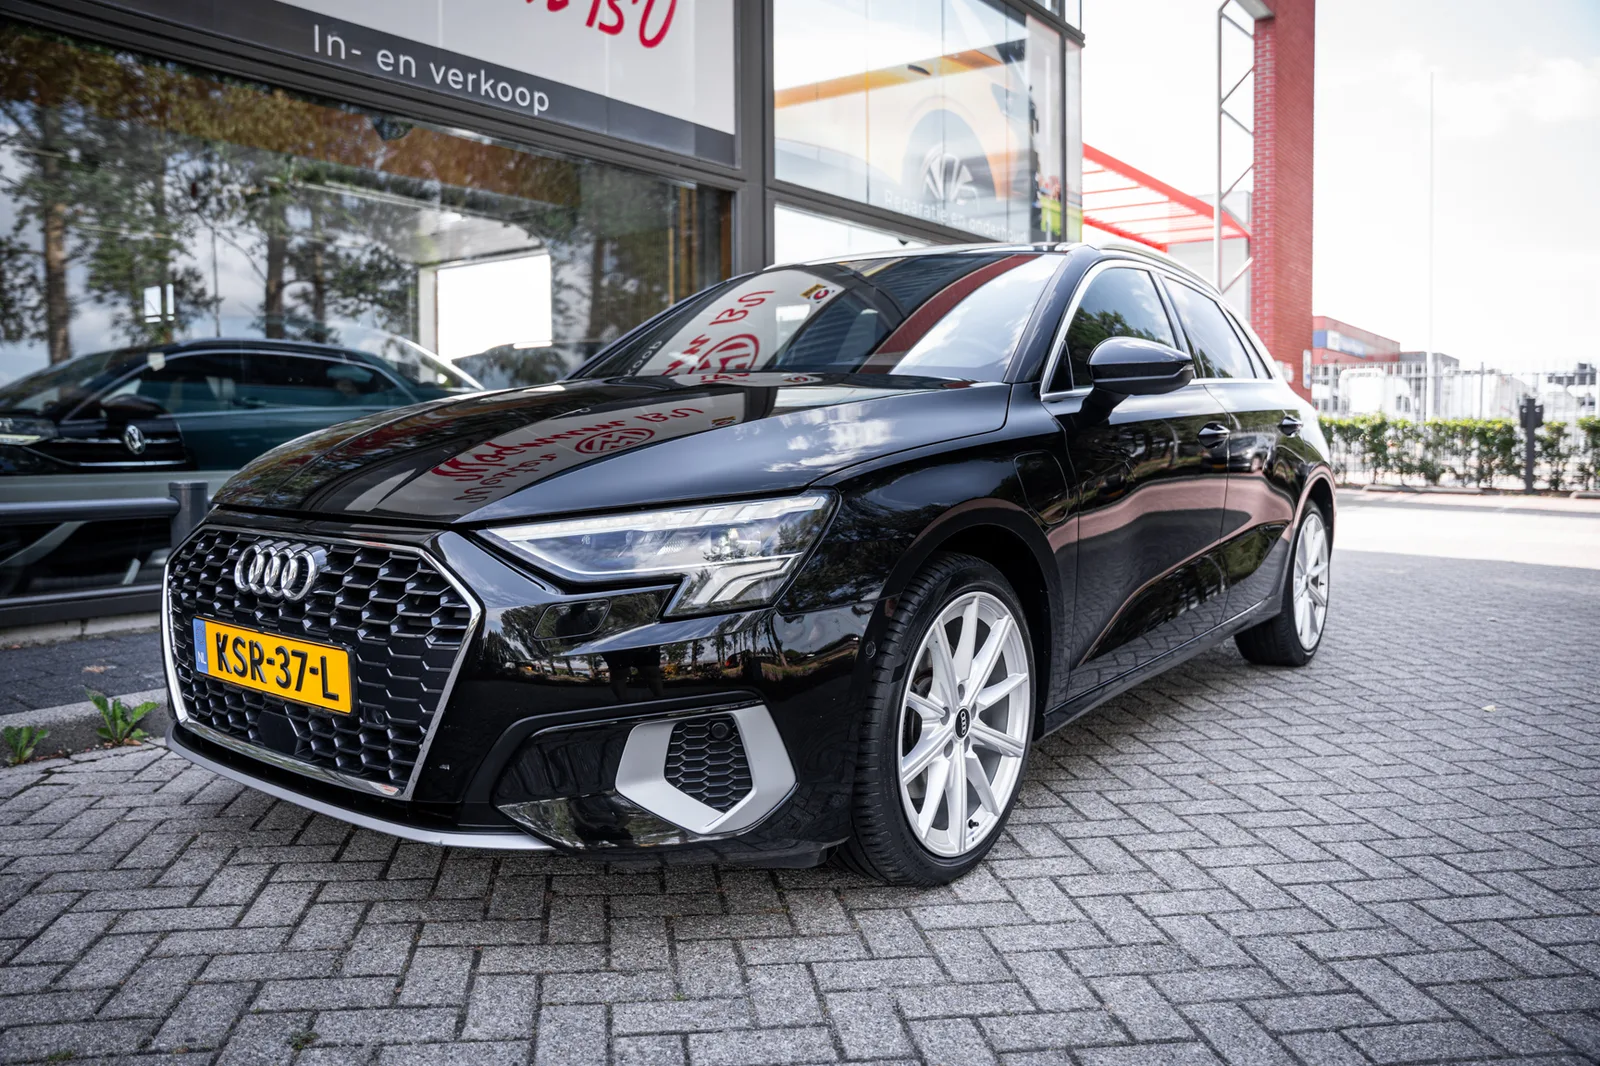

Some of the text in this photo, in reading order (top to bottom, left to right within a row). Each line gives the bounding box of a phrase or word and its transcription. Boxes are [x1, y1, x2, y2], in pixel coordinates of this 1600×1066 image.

[313, 25, 550, 115] In- en verkoop
[885, 189, 948, 223] Reparatie
[951, 212, 966, 227] en
[197, 651, 207, 665] NL
[216, 631, 340, 702] KSR-37-L
